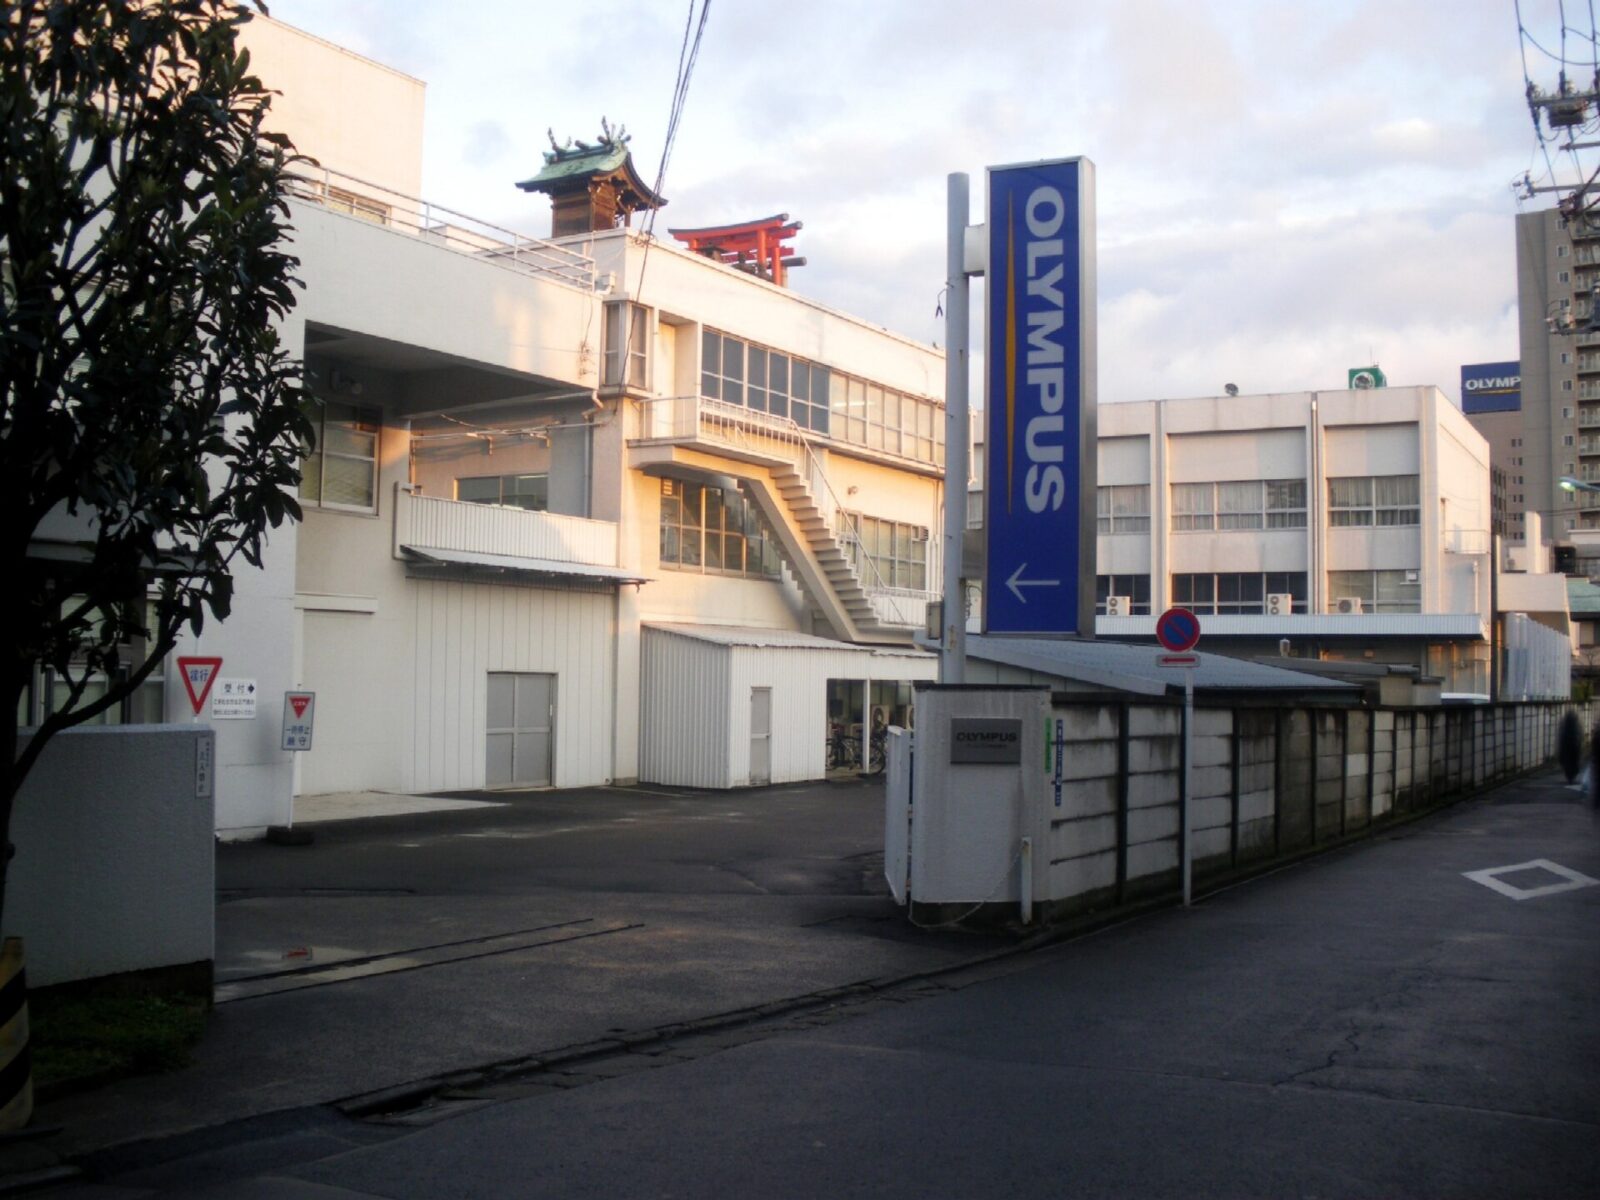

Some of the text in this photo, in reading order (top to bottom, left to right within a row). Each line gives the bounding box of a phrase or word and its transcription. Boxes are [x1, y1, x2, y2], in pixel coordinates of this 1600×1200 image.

[1023, 184, 1066, 515] OLYMPUS
[1465, 375, 1521, 391] OLYMP
[956, 731, 1017, 742] OLYMPUS
